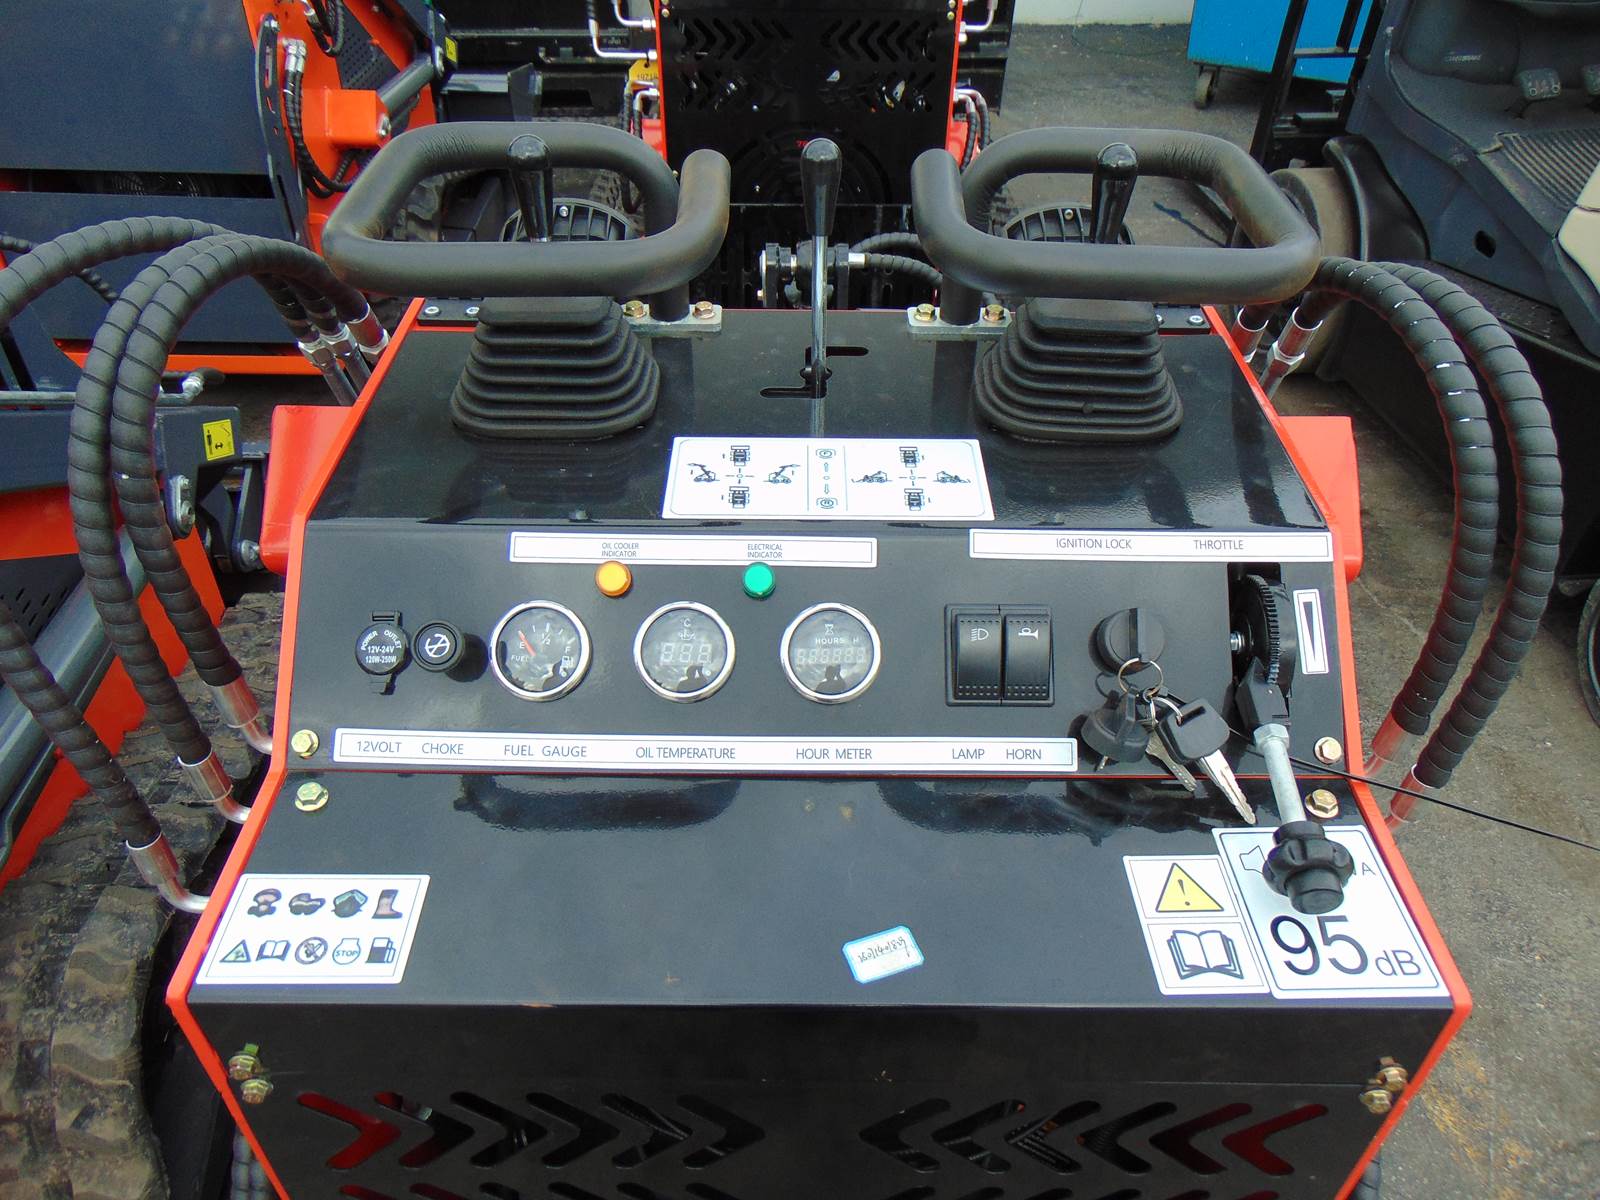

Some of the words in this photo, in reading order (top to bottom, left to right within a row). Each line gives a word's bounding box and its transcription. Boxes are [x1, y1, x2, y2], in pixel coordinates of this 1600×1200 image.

[601, 542, 612, 550] OIL
[614, 542, 640, 550] COOLER
[747, 543, 783, 551] ELECTRICAL
[1056, 538, 1102, 548] IGNITION
[1106, 539, 1132, 549] LOCK
[1193, 540, 1244, 550] THROTTLE
[601, 550, 637, 558] INDICATOR
[747, 551, 783, 559] INDICATOR
[361, 630, 378, 651] POWER
[384, 629, 402, 649] OUTLET
[815, 637, 845, 645] HOURS
[367, 645, 395, 653] 12V-24V
[565, 646, 571, 654] F
[365, 656, 397, 664] 120W-250W
[356, 741, 402, 753] 12VOLT
[421, 743, 464, 755] CHOKE
[504, 745, 534, 756] FUEL
[542, 745, 588, 757] GAUGE
[635, 747, 654, 758] OIL
[656, 747, 736, 759] TEMPERATURE
[796, 748, 830, 759] HOUR
[835, 748, 873, 760] METER
[952, 748, 985, 760] LAMP
[1006, 748, 1042, 760] HORN
[1270, 915, 1369, 976] 95
[1375, 949, 1422, 977] dB
